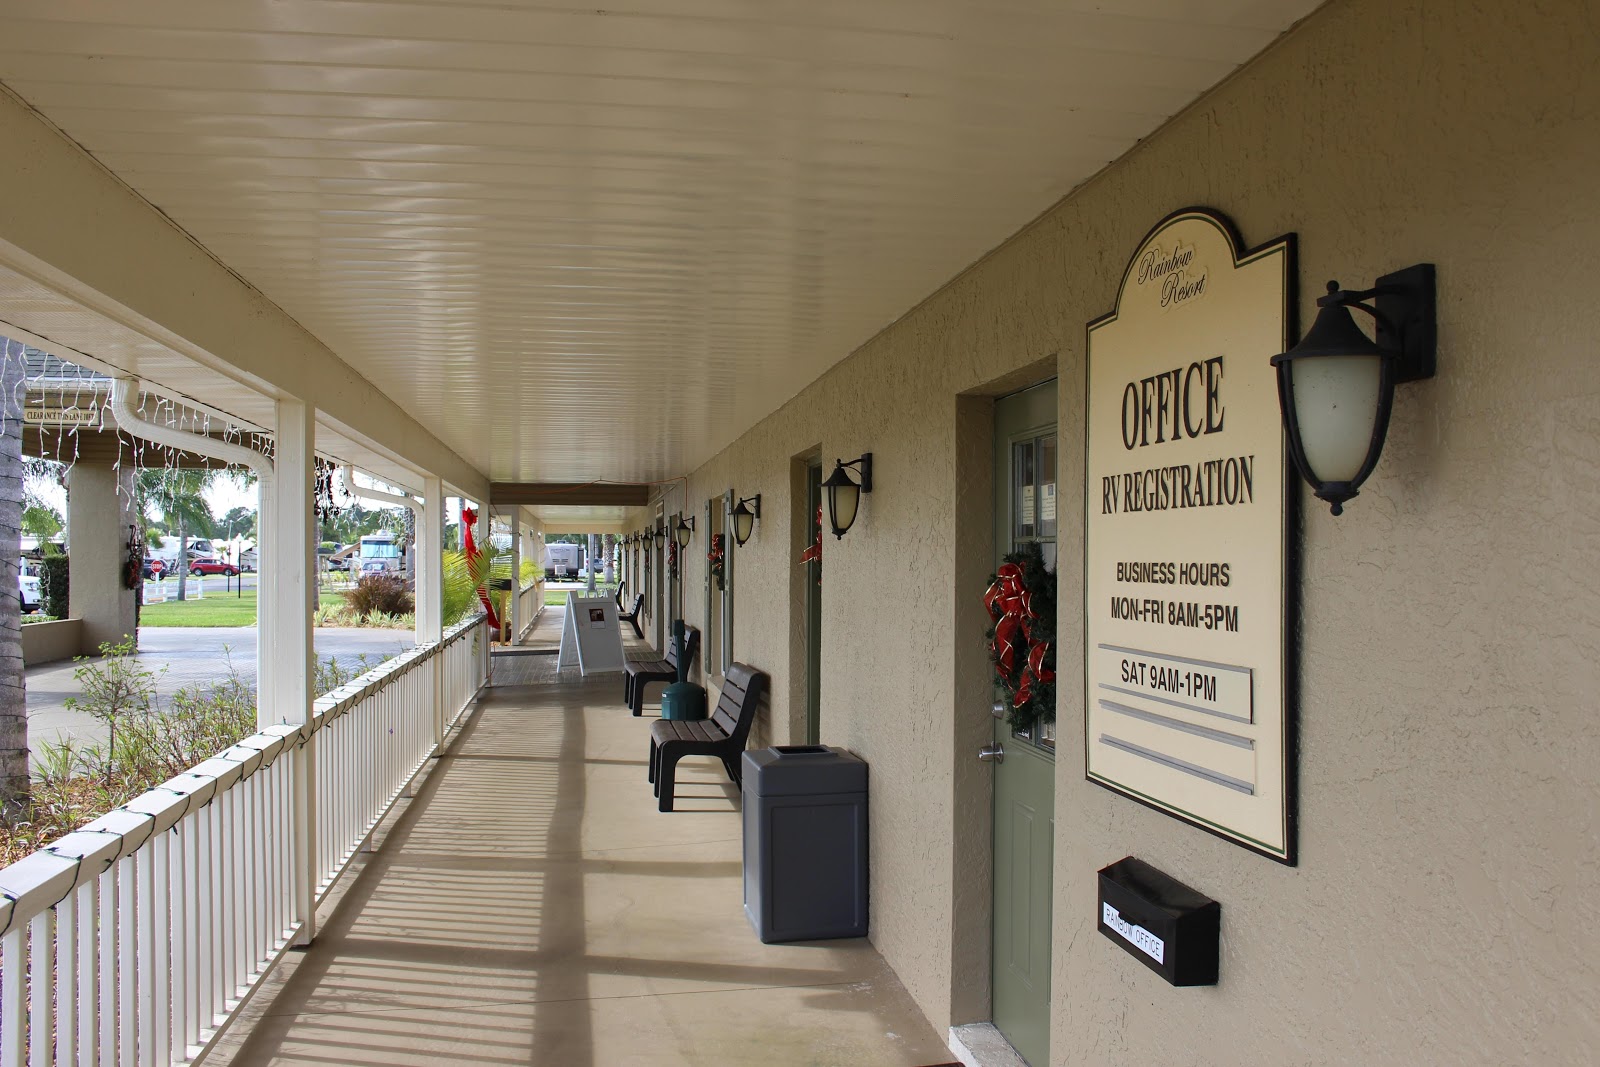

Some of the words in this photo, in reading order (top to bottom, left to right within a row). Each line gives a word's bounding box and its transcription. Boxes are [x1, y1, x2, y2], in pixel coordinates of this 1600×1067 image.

[1138, 246, 1193, 286] Rainbow
[1161, 269, 1206, 308] Resort
[57, 412, 69, 420] TIS
[1121, 355, 1225, 451] OFFICE
[1102, 474, 1121, 515] RV
[1123, 455, 1255, 513] REGISTRATION
[1117, 561, 1176, 585] BUSINESS
[1179, 562, 1231, 588] HOURS
[1111, 596, 1164, 624] MON-FRI
[1168, 601, 1239, 633] 8AM-5PM
[1121, 658, 1147, 686] SAT
[1150, 665, 1217, 702] 9AM-1PM
[1106, 908, 1133, 938] RAINBOW
[1135, 929, 1161, 957] OFFICE
